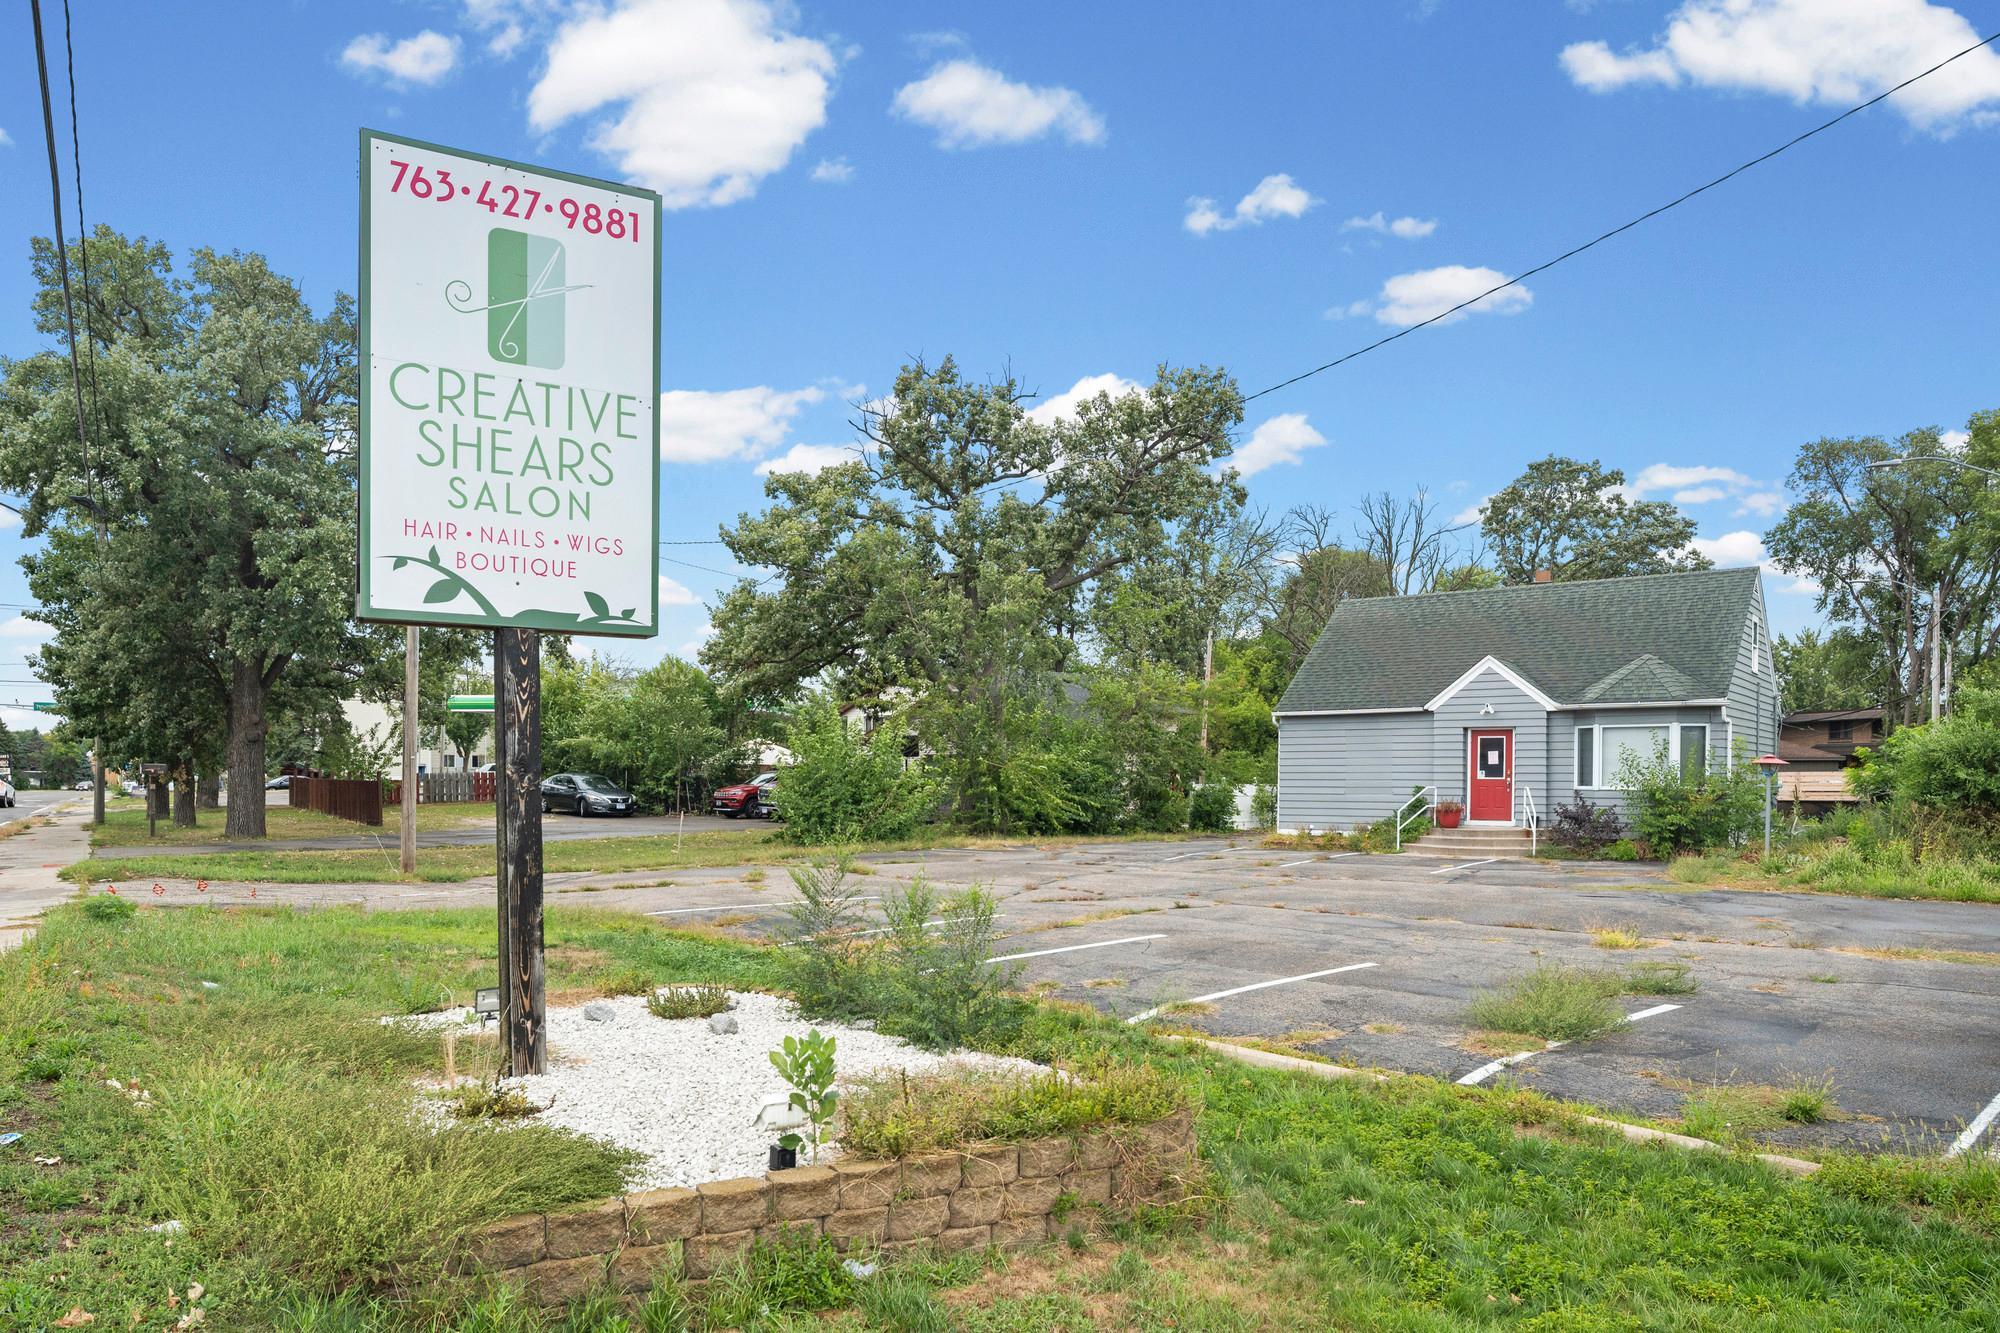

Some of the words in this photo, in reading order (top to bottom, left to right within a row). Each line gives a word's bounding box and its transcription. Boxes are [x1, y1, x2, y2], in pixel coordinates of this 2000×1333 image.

[389, 362, 639, 439] CREATIVE
[416, 419, 615, 486] SHEARS
[448, 476, 591, 520] SALON
[404, 518, 458, 541] HAIR
[479, 525, 546, 549] NAILS
[566, 533, 624, 556] WIGS
[455, 551, 577, 579] BOUTIQUE
